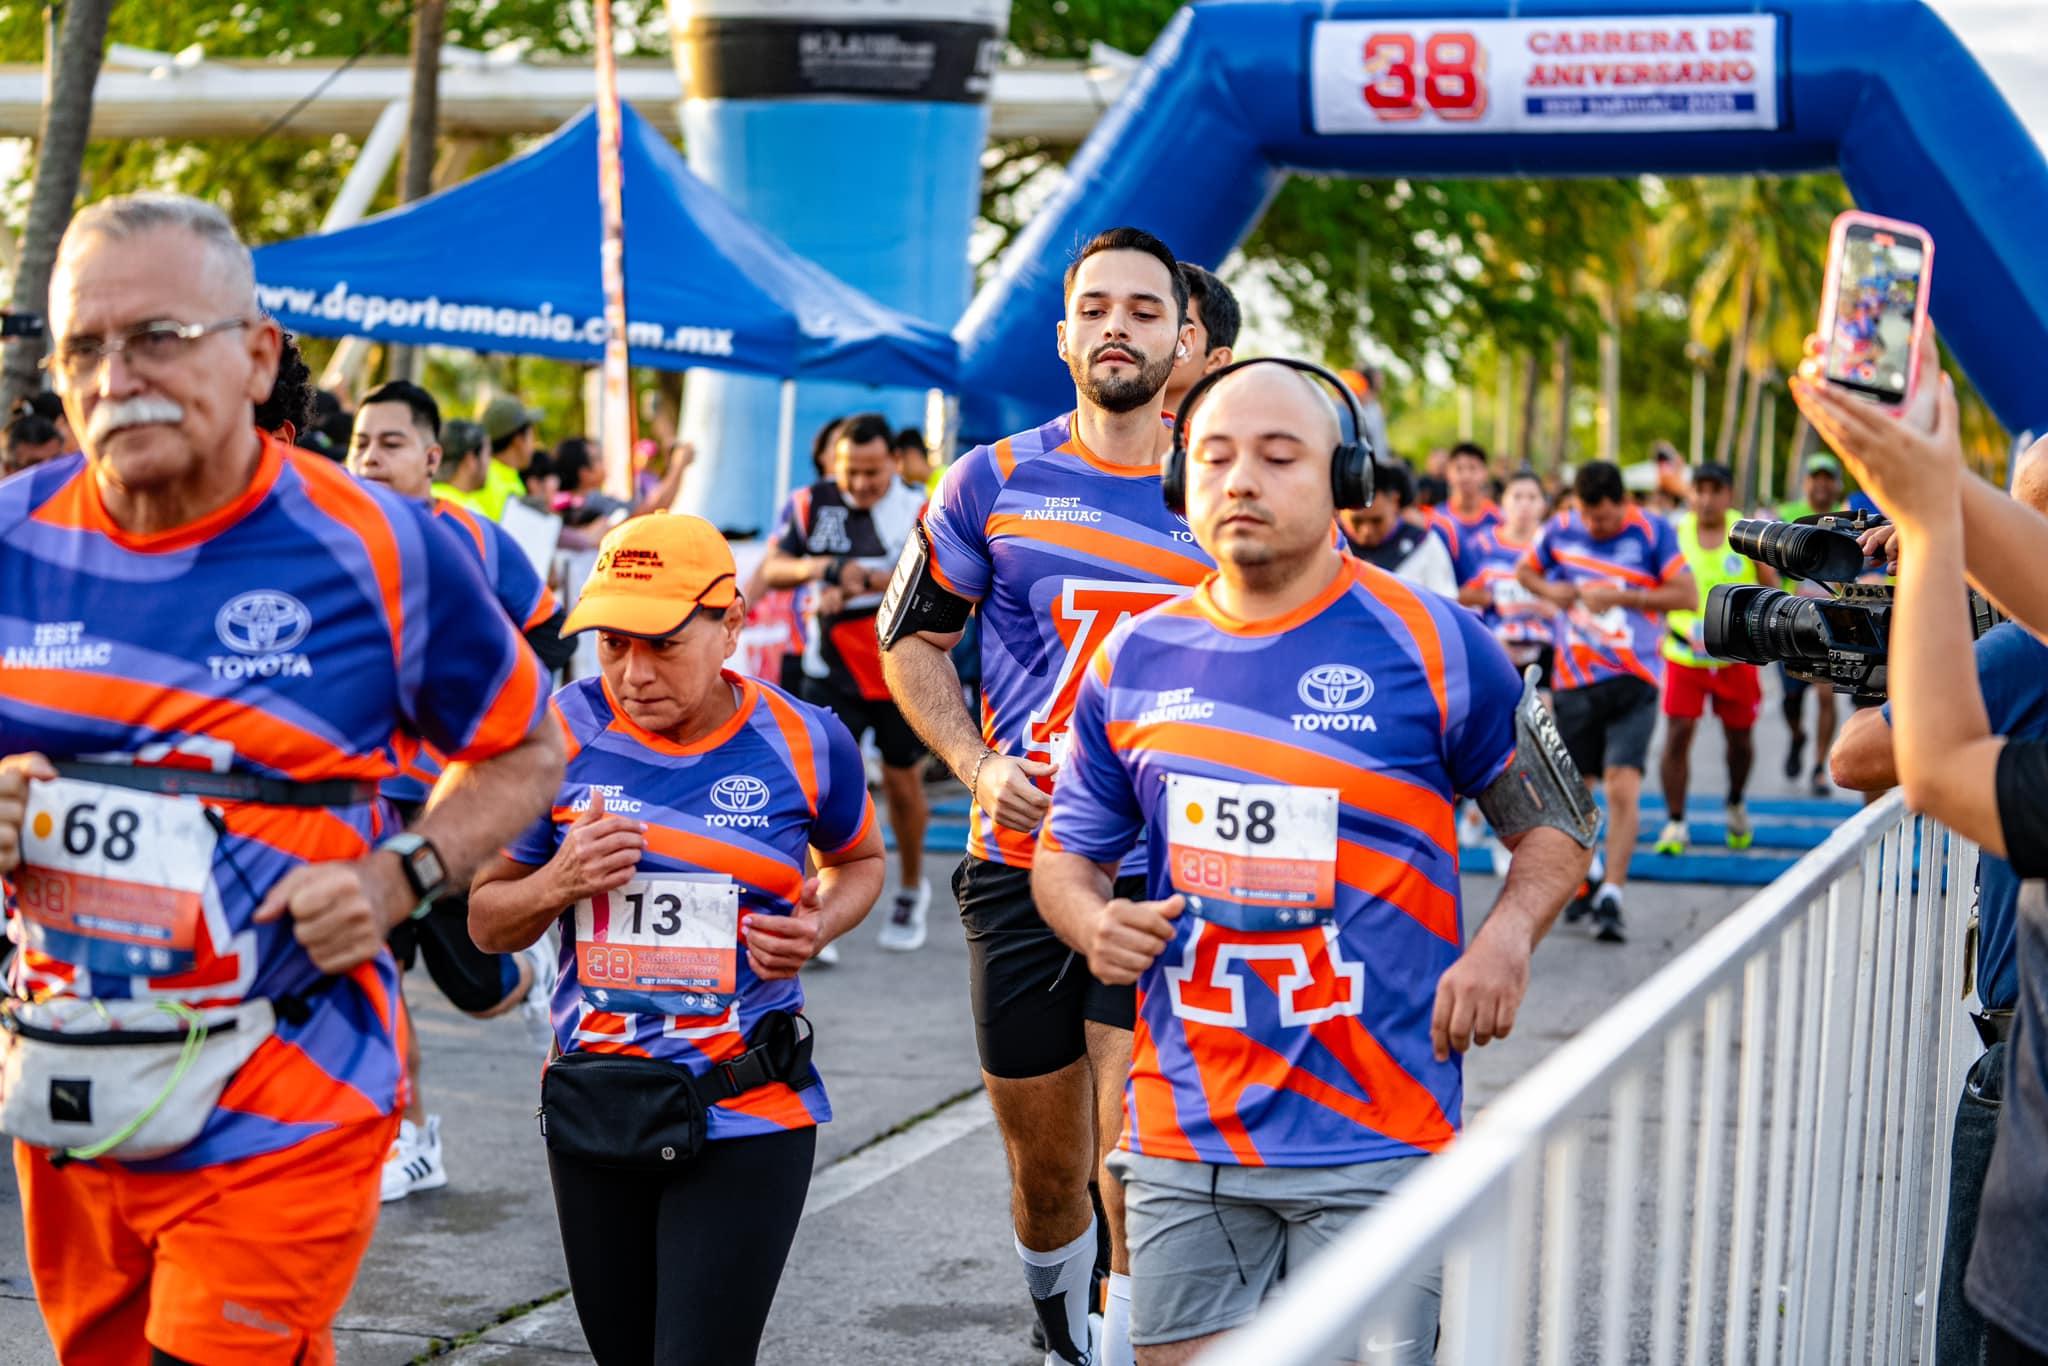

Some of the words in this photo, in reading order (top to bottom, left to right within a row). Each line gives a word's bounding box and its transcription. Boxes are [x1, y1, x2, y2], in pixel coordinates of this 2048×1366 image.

[1527, 31, 1698, 56] CARRERA
[1709, 29, 1754, 52] DE
[1364, 32, 1488, 121] 38
[1526, 61, 1756, 88] ANIVERSARIO
[1021, 506, 1101, 522] ANÁHUAC
[1044, 496, 1081, 508] IEST
[34, 621, 84, 646] IEST
[207, 653, 313, 679] TOYOTA
[1157, 687, 1194, 708] IEST
[1291, 714, 1377, 732] TOYOTA
[63, 803, 140, 861] 68
[704, 814, 770, 828] TOYOTA
[1216, 796, 1275, 844] 58
[1181, 850, 1227, 891] 38
[625, 893, 682, 936] 13
[587, 946, 633, 984] 38
